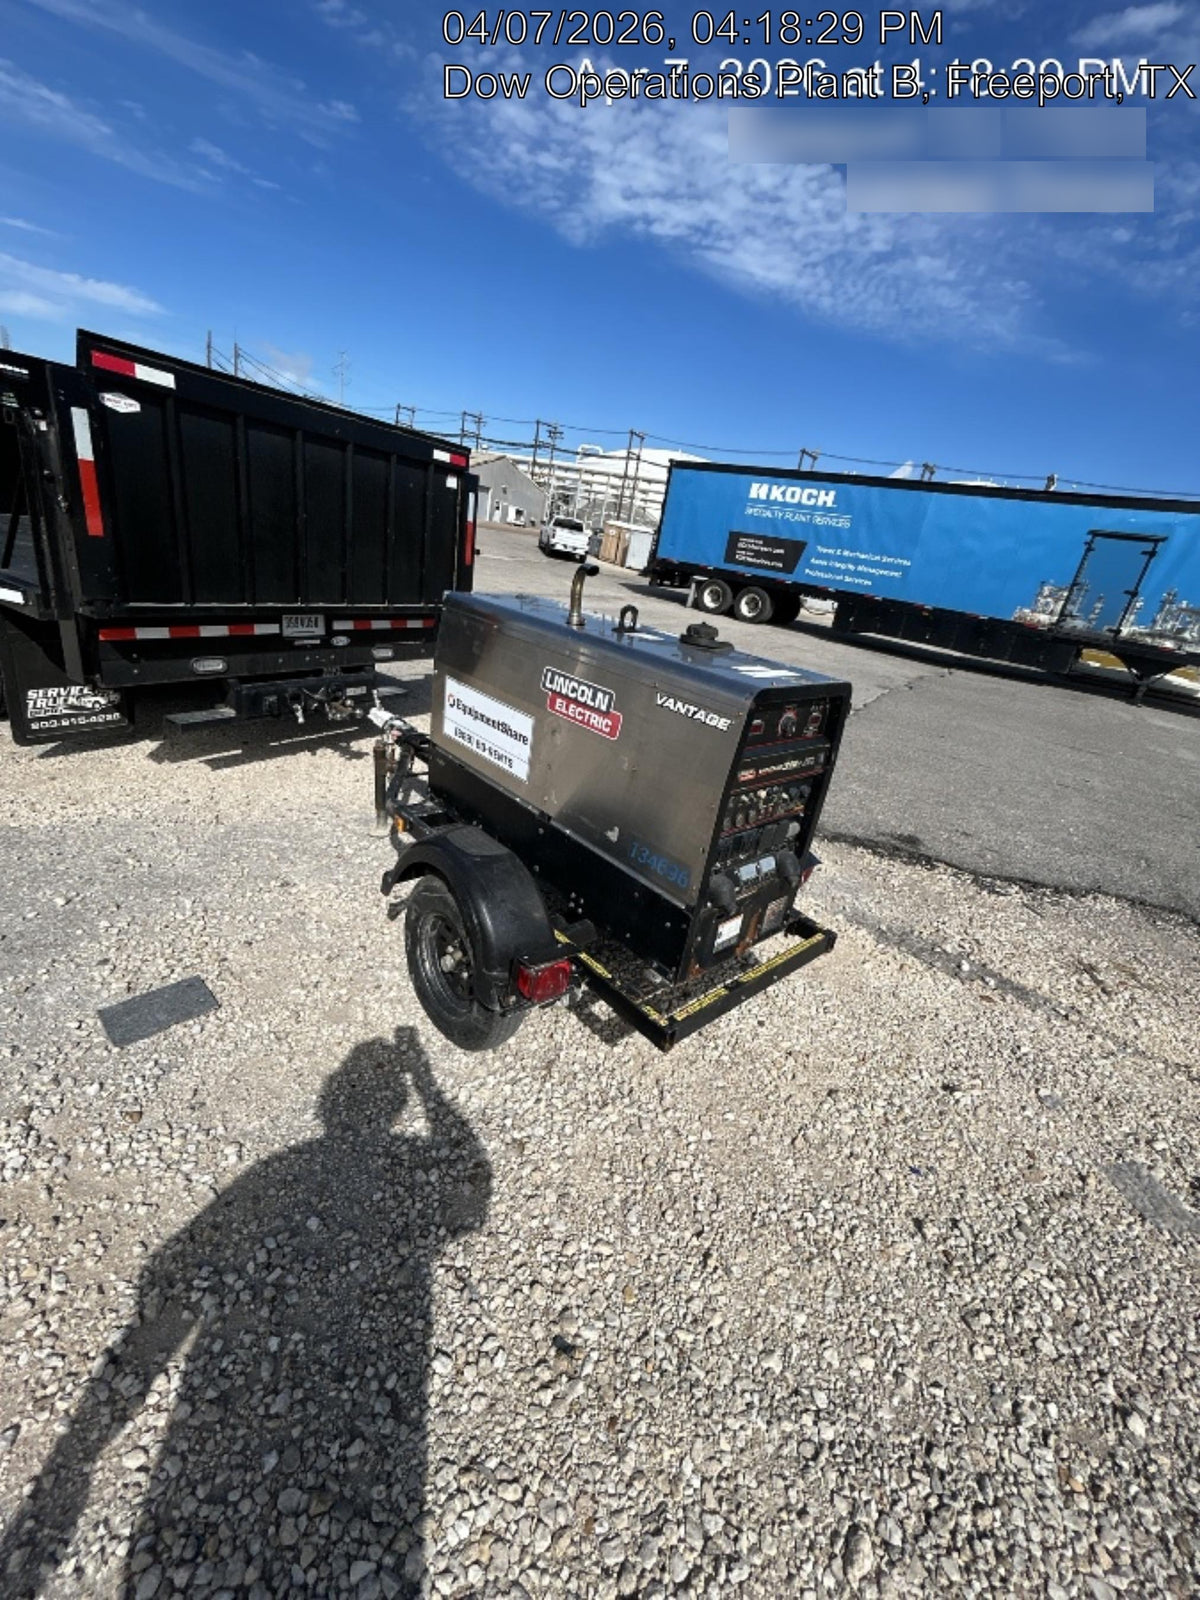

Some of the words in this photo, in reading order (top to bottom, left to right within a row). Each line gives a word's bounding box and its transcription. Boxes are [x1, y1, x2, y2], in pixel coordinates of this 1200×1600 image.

[769, 484, 837, 508] KOCH
[545, 671, 610, 712] LINCOLN
[456, 698, 530, 746] EquipmentShare
[555, 698, 613, 733] ELECTRIC
[656, 692, 732, 731] VANTAGE
